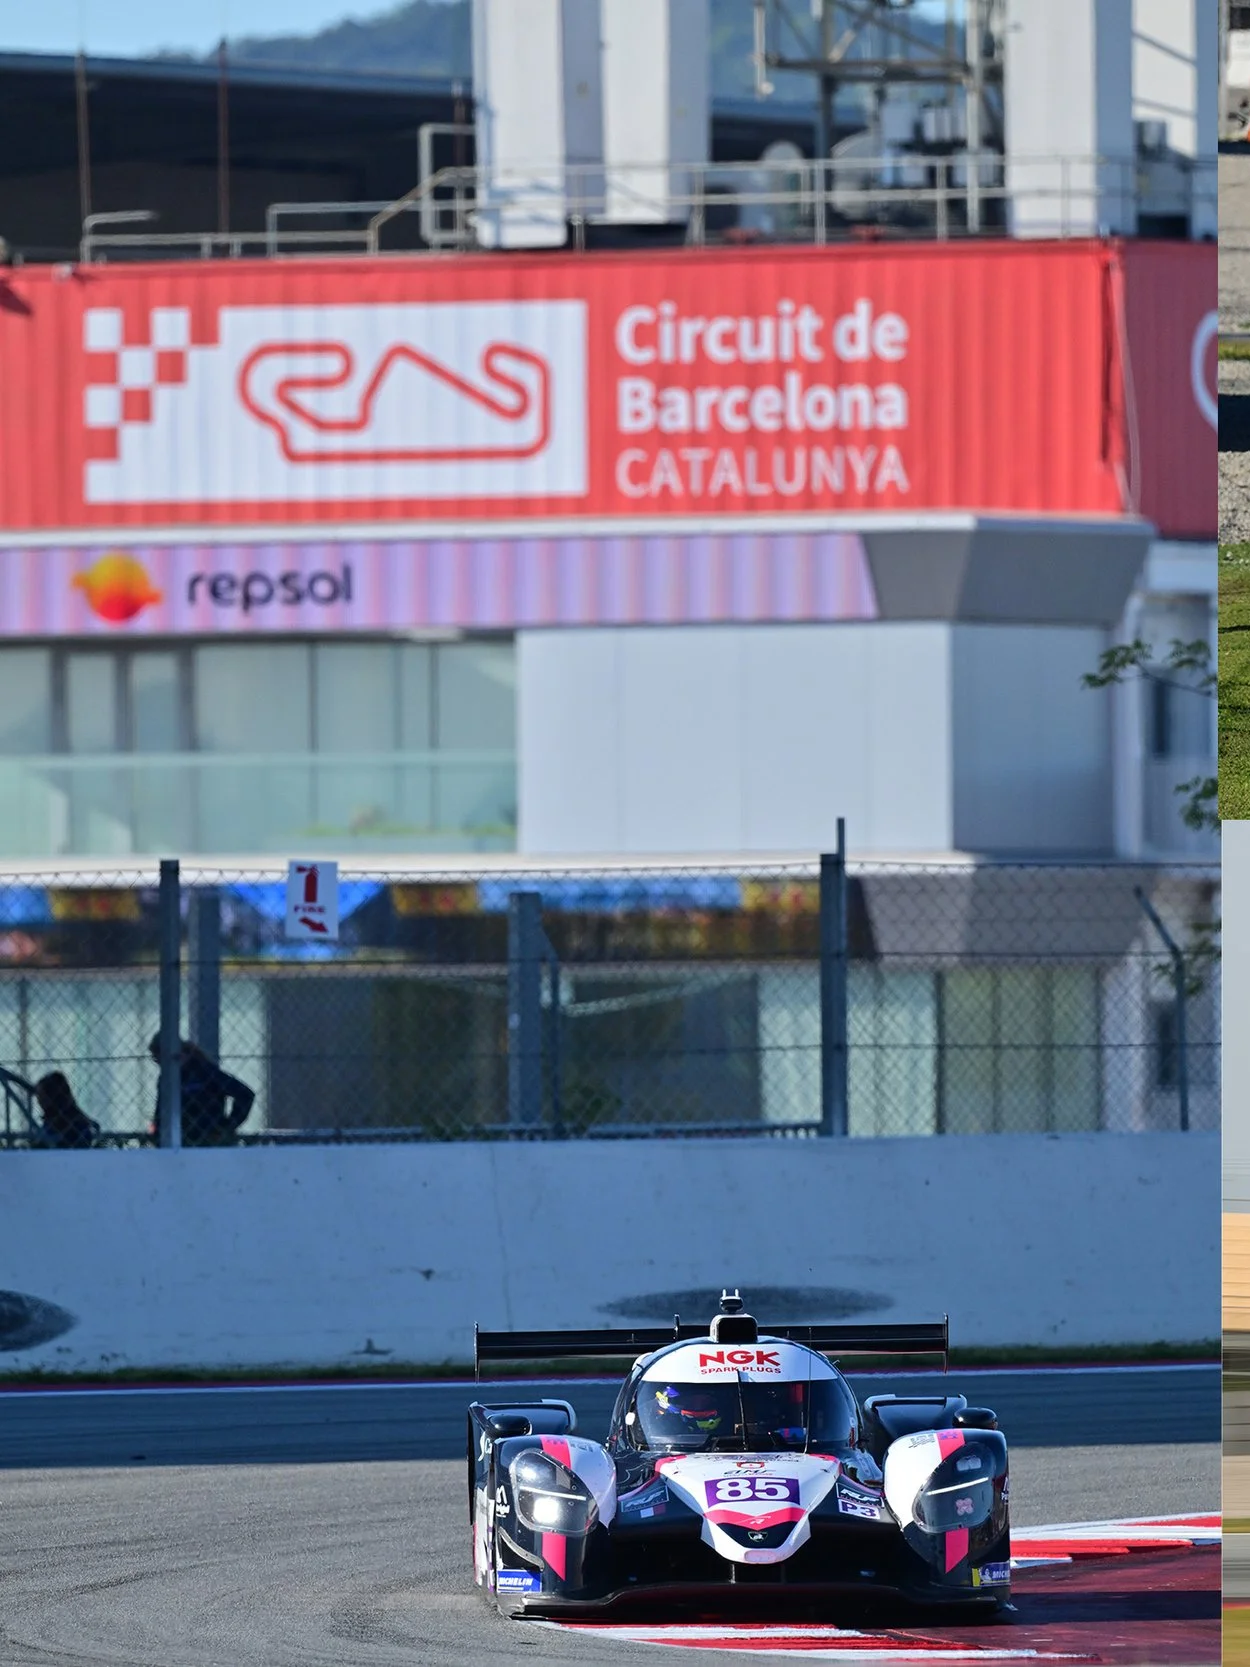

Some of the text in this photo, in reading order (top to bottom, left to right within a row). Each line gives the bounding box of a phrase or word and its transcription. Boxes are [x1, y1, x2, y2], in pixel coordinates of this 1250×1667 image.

[616, 298, 909, 365] Circuit de
[617, 371, 908, 434] Barcelona
[616, 445, 909, 497] CATALUNYA
[187, 563, 353, 612] repsol
[294, 905, 326, 914] FIRE
[699, 1350, 781, 1367] NGK
[700, 1366, 781, 1375] SPARK PLUGS
[715, 1478, 790, 1501] 85
[842, 1501, 877, 1516] P3
